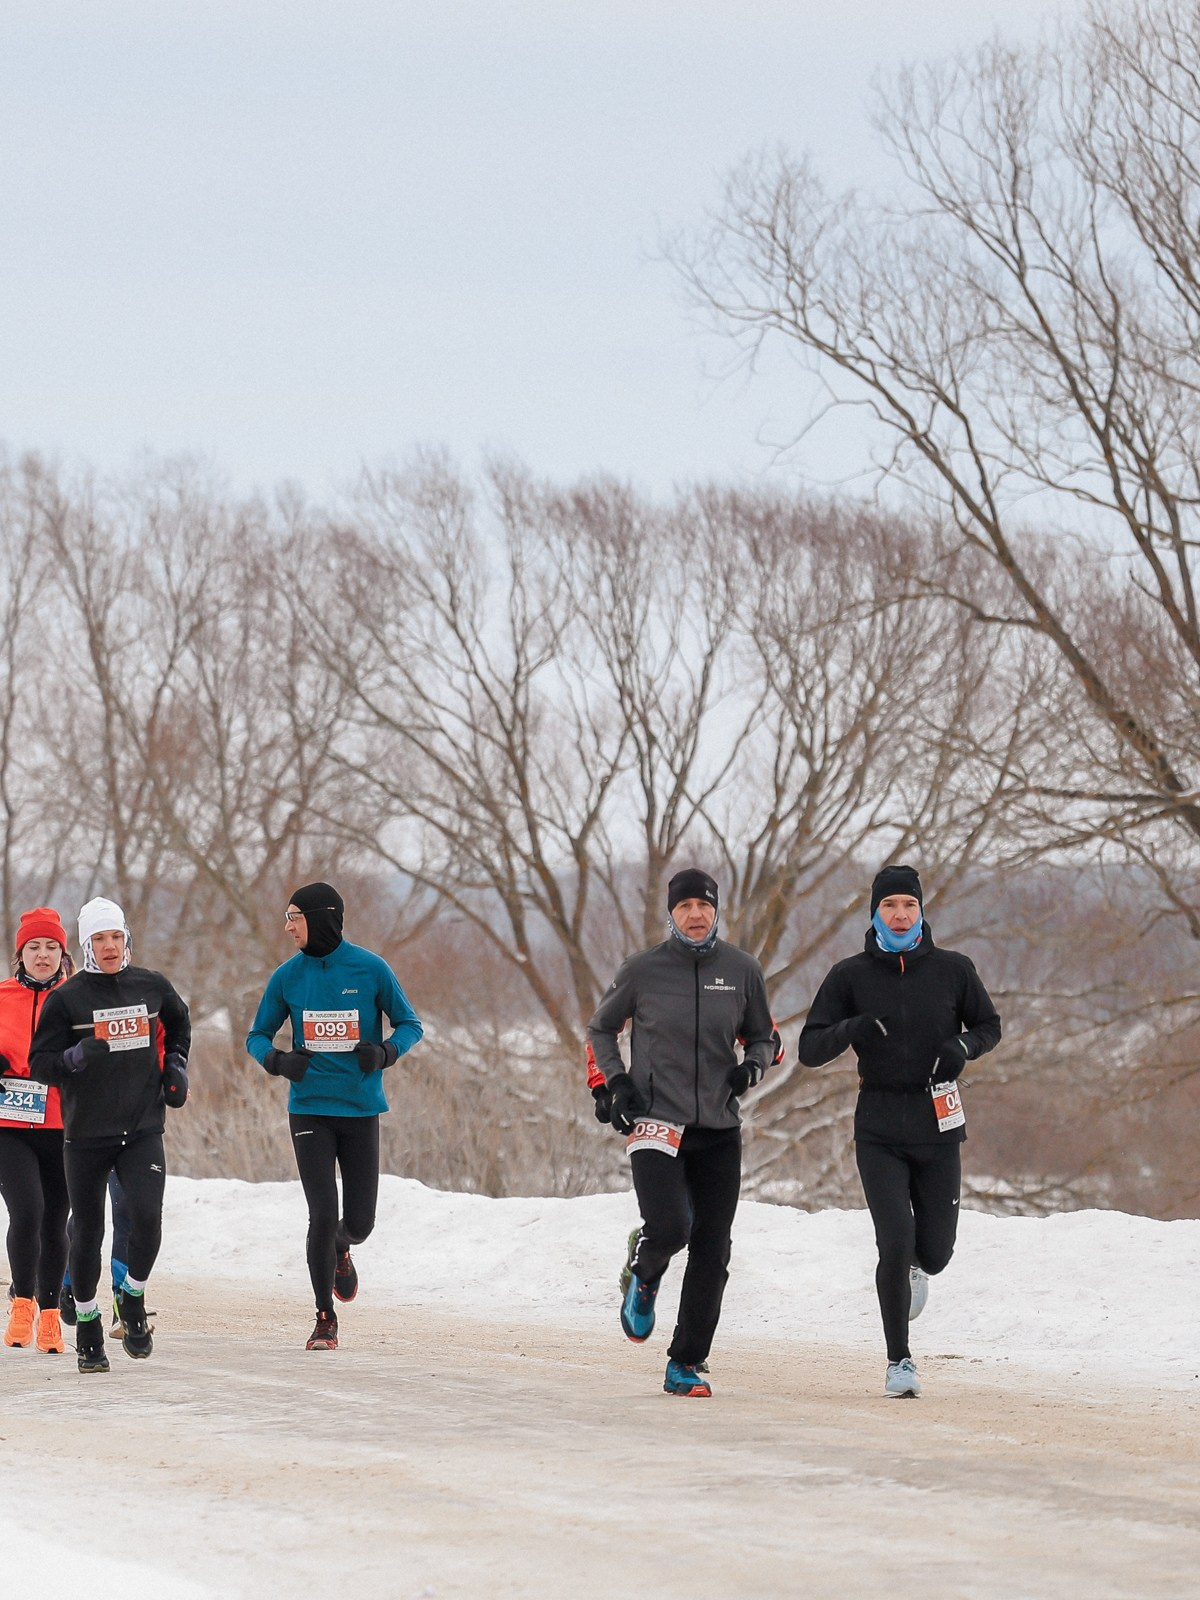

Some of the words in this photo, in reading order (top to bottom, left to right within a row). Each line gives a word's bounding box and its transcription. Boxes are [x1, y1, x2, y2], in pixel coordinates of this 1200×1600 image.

[108, 1018, 138, 1036] 013
[314, 1022, 347, 1037] 099
[3, 1090, 35, 1108] 234
[634, 1122, 670, 1140] 092
